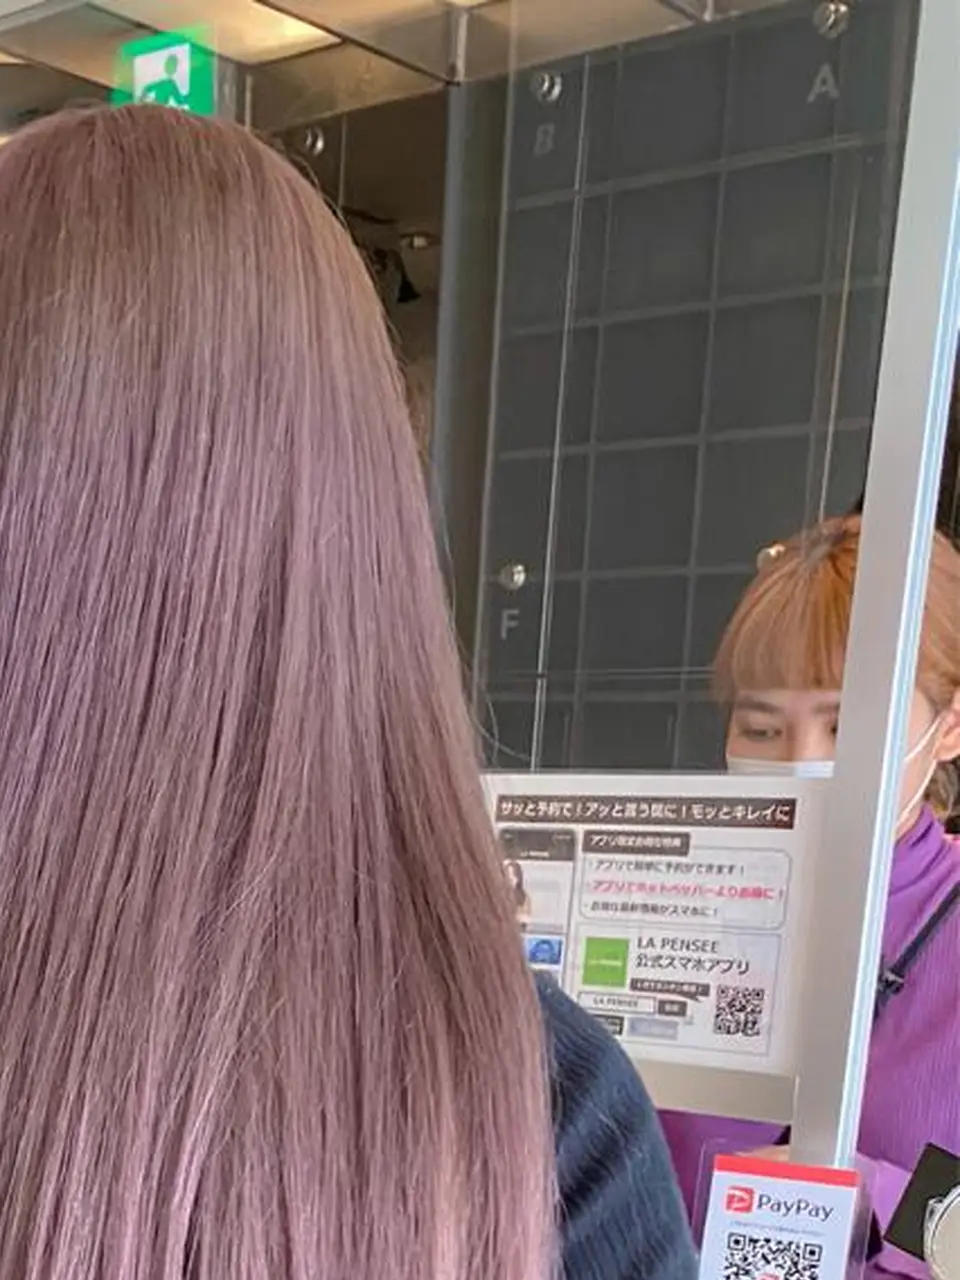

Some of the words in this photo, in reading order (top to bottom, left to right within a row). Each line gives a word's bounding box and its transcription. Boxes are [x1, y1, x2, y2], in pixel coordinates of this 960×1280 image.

[807, 62, 839, 103] A
[500, 609, 519, 640] F
[637, 937, 656, 951] LA
[661, 937, 719, 954] PENSEE
[635, 953, 750, 976] 公式スマホアプリ
[757, 1193, 835, 1222] PayPay
